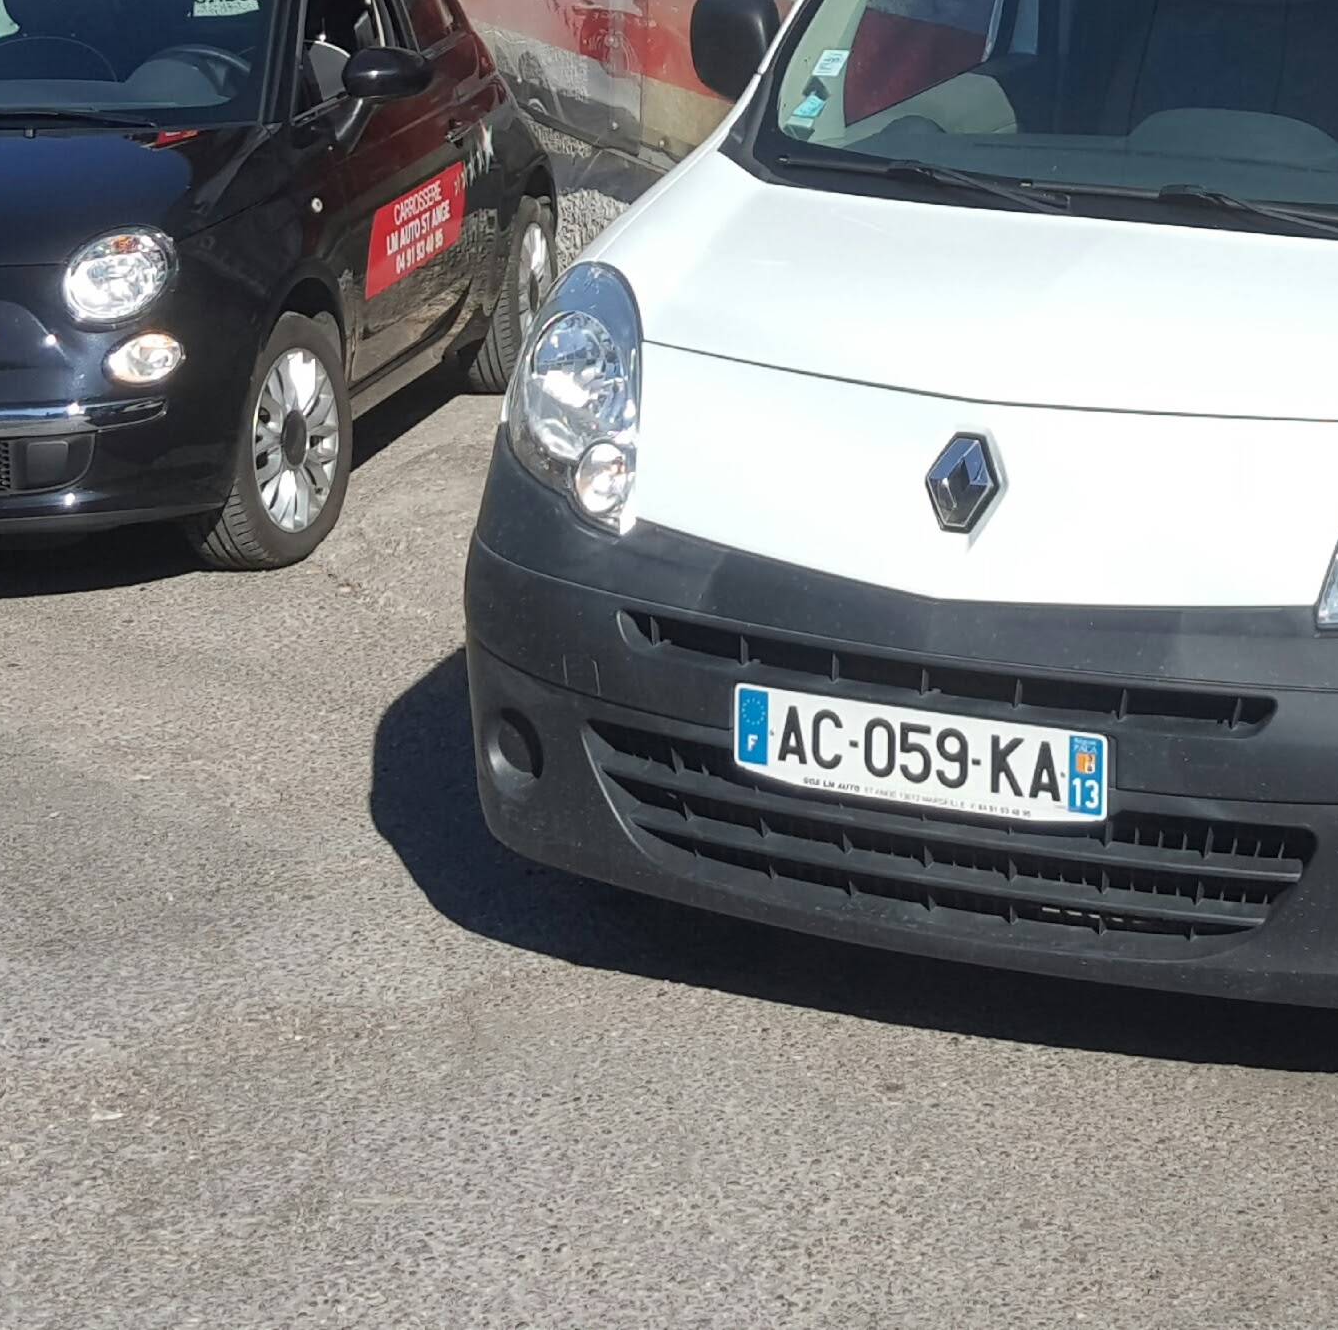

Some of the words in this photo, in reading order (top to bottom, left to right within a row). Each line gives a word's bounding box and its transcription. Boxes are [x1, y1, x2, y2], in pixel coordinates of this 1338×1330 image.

[386, 230, 399, 257] LM
[399, 218, 420, 249] AUTO
[420, 211, 431, 235] ST
[431, 199, 451, 229] ANGE
[747, 734, 758, 753] F
[777, 704, 1062, 803] AC-059-KA
[1071, 776, 1100, 810] 13
